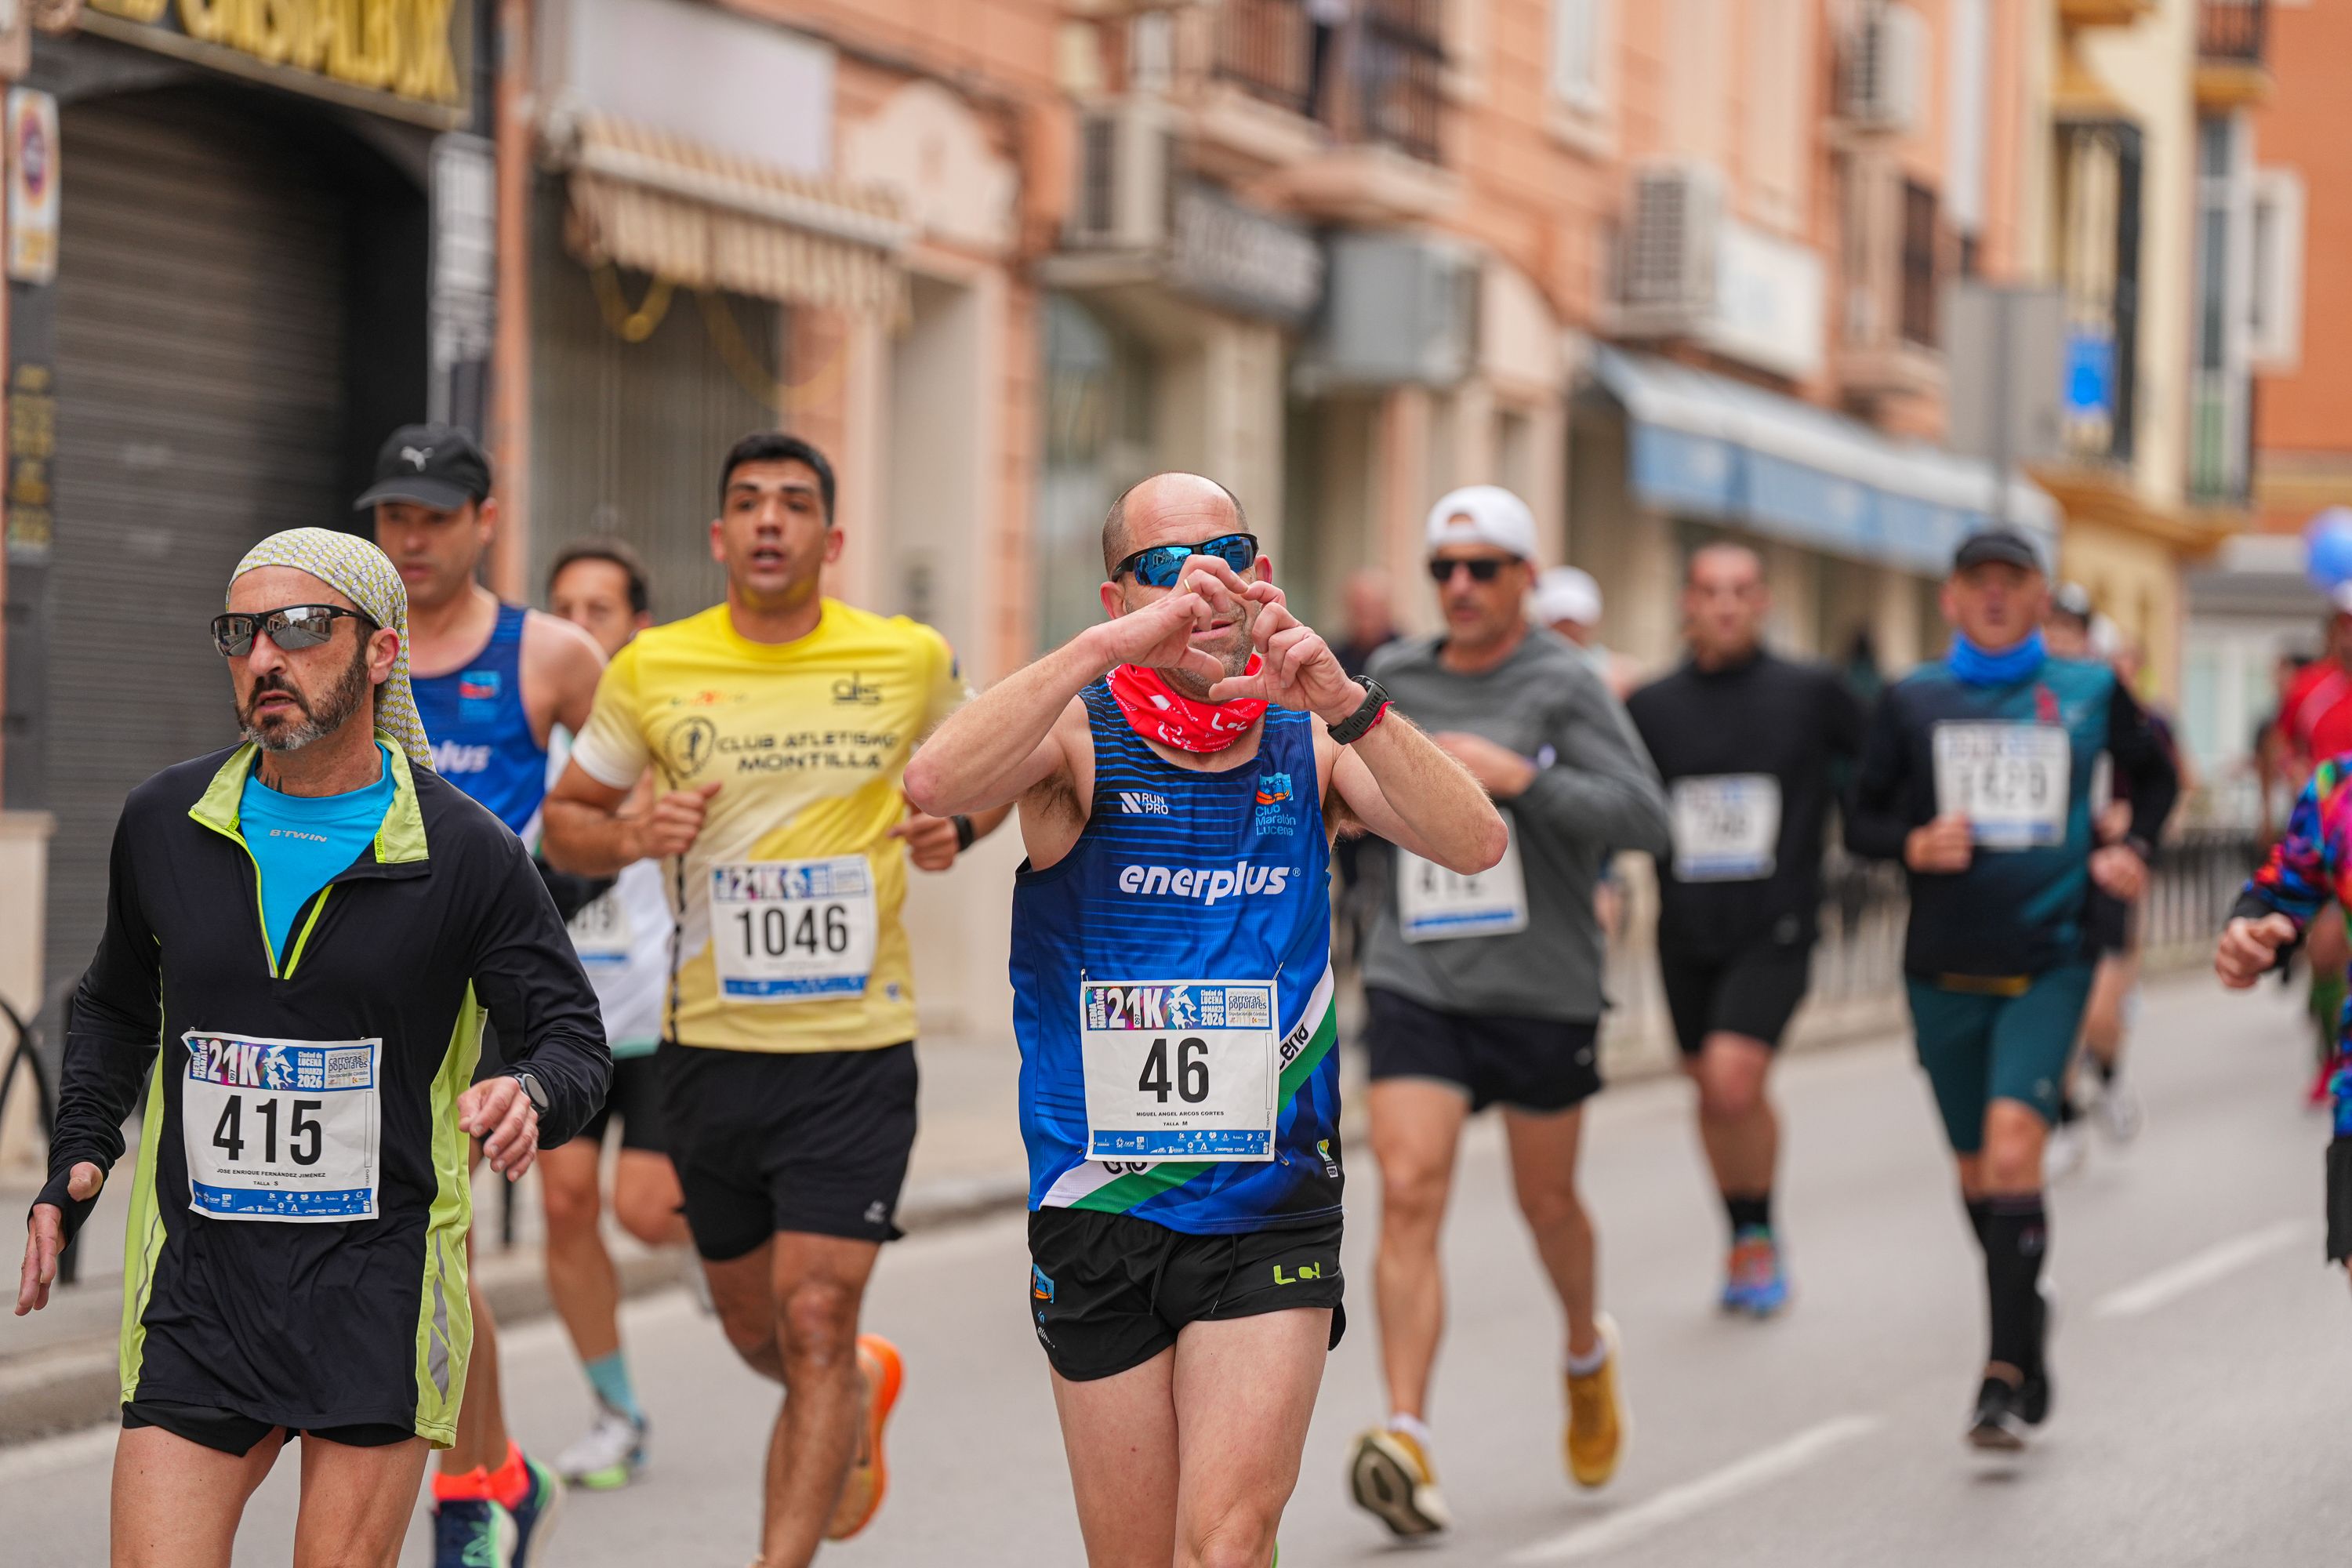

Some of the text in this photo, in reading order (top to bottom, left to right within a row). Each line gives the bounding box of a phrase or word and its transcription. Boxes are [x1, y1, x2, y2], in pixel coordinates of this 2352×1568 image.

[716, 731, 898, 753] CLUB ATLETISMO
[738, 751, 882, 774] MONTILLA
[1142, 792, 1165, 805] RUN
[1145, 803, 1169, 815] PRO
[1255, 806, 1281, 817] Club
[1255, 815, 1296, 827] Maratón
[1256, 826, 1294, 837] Lucena
[734, 904, 848, 957] 1046
[1201, 996, 1223, 1005] LUCENA
[1229, 1002, 1267, 1011] populares
[1107, 988, 1165, 1029] 21K
[1201, 1013, 1225, 1026] 2026
[208, 1040, 260, 1087] 21K
[298, 1058, 323, 1067] LUCENA
[328, 1055, 362, 1065] carreras
[328, 1061, 368, 1073] populares
[1138, 1036, 1210, 1104] 46
[297, 1075, 323, 1088] 2026
[212, 1094, 323, 1167] 415
